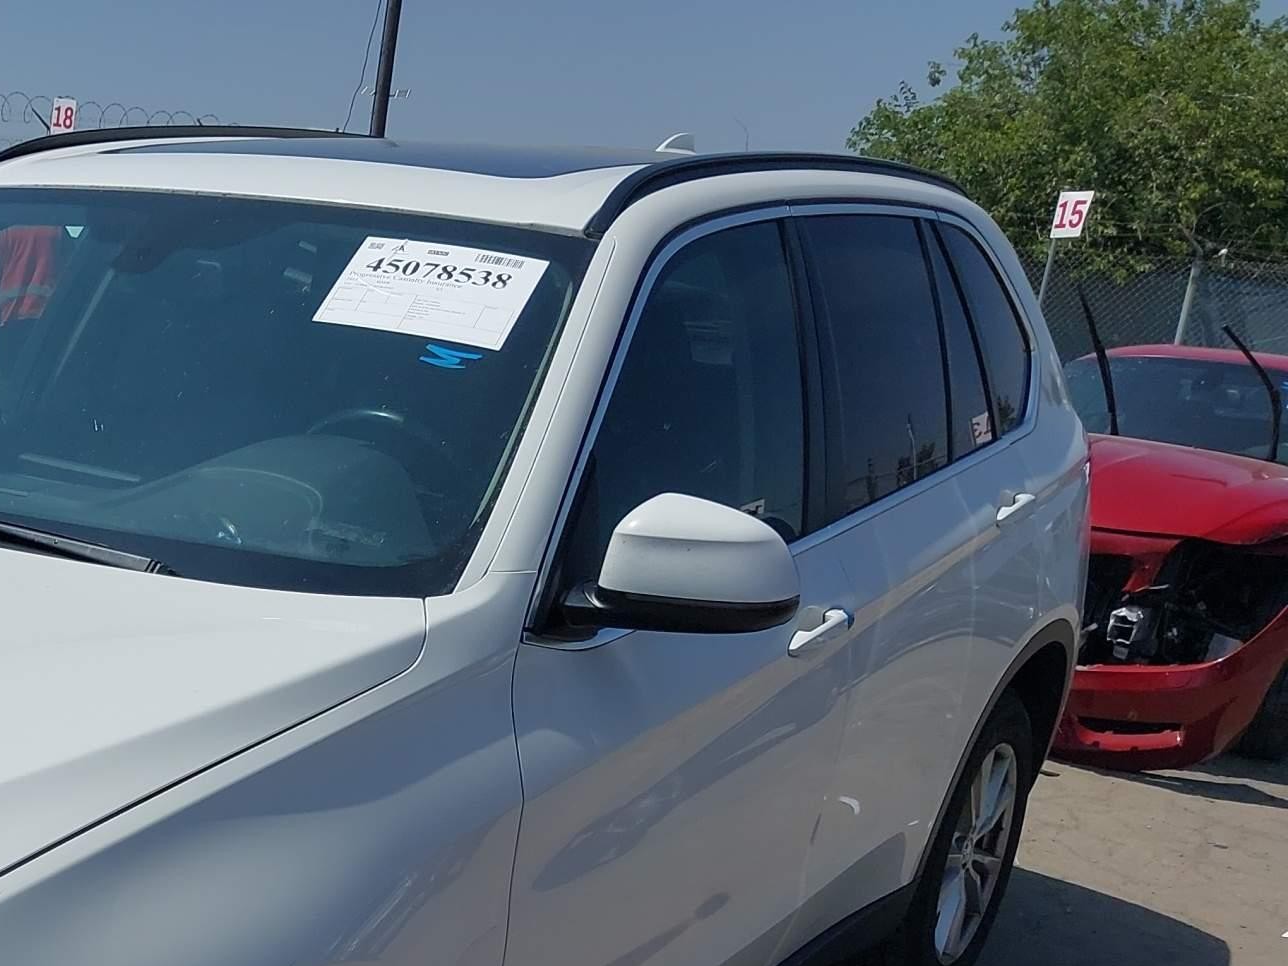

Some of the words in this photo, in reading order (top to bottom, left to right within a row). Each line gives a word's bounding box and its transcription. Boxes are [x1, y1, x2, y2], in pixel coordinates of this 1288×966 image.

[53, 106, 73, 129] 18
[1054, 199, 1088, 229] 15
[366, 257, 512, 290] 45078538
